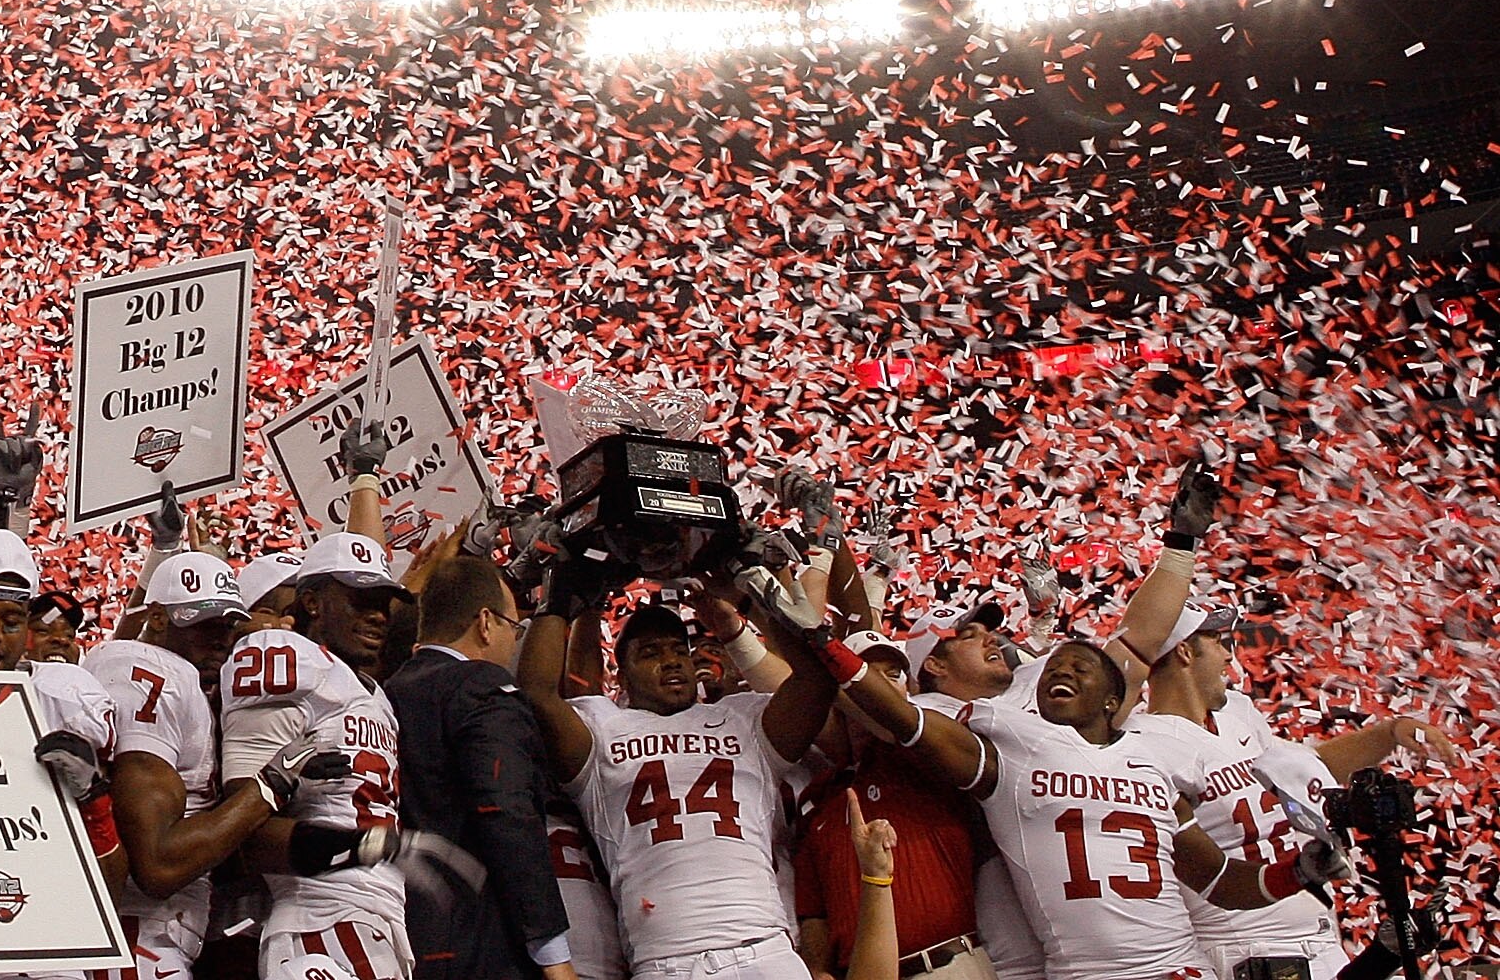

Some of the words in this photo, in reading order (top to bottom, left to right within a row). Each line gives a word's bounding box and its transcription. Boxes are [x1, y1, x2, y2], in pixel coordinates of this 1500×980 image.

[124, 283, 204, 326] 2010
[118, 338, 167, 374] Big
[173, 327, 205, 360] 12
[101, 367, 218, 421] Champs!
[351, 542, 372, 563] OU
[181, 569, 201, 593] OU
[232, 645, 297, 697] 20
[131, 666, 165, 724] 7
[610, 734, 741, 764] SOONERS
[626, 757, 745, 845] 44
[1031, 770, 1169, 811] SOONERS
[1055, 808, 1163, 900] 13
[0, 880, 20, 894] 12
